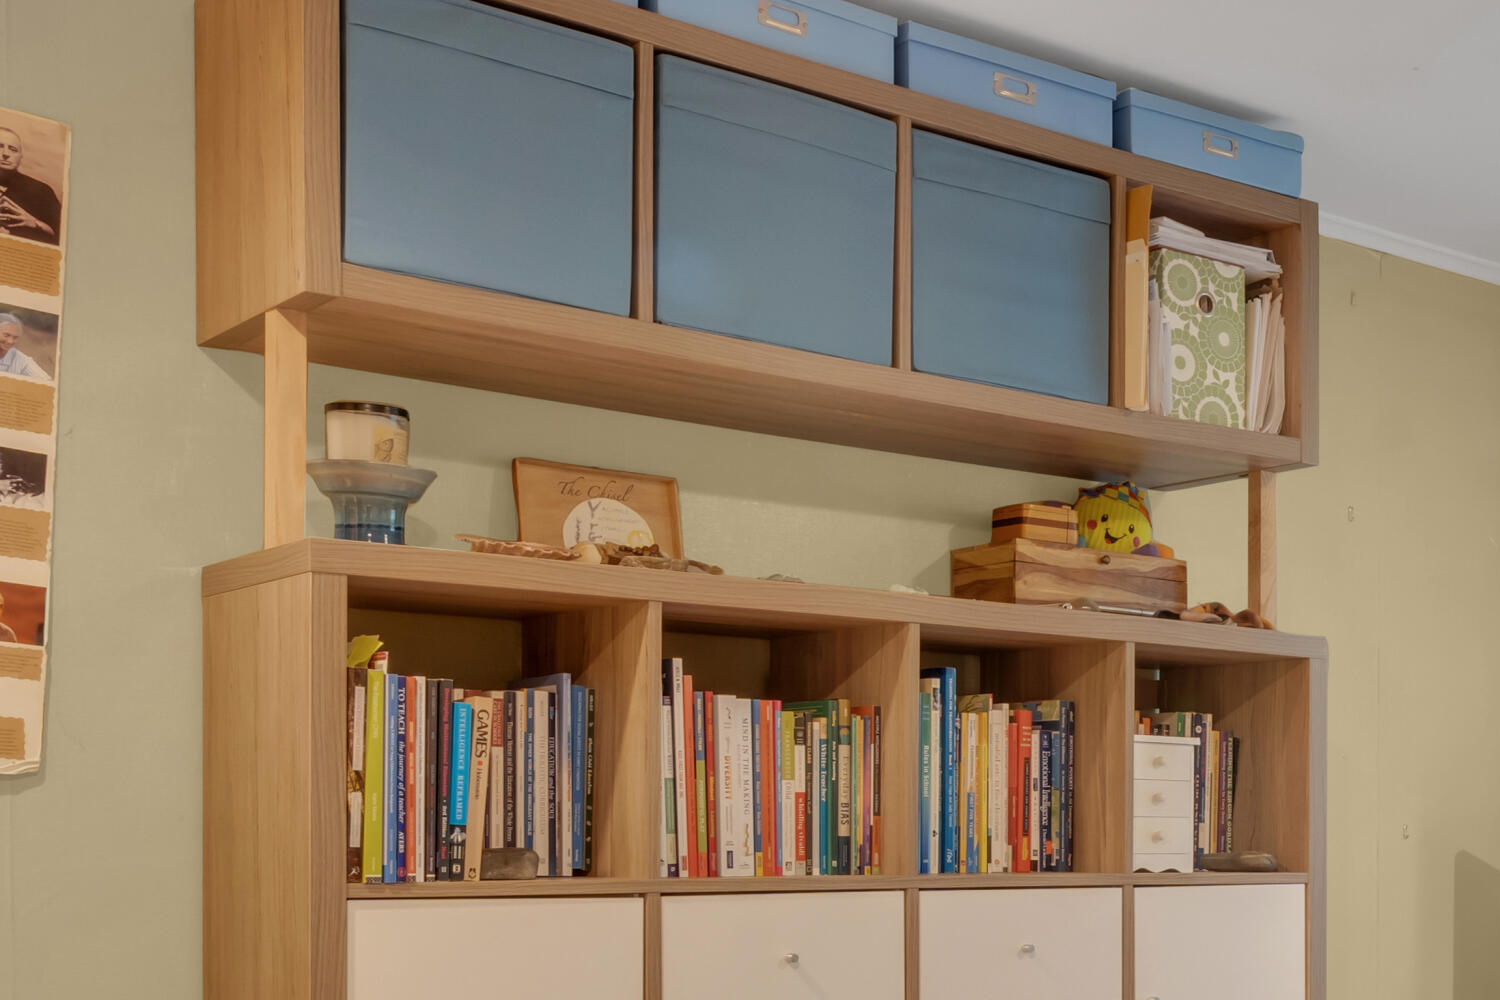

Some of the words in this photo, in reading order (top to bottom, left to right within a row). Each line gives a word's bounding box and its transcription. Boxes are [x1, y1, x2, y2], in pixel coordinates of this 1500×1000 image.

[558, 477, 584, 497] The
[398, 687, 406, 701] TO
[398, 702, 406, 734] TEACH
[475, 709, 490, 759] GAMES
[457, 708, 466, 769] INTELLIGENCE
[742, 744, 749, 754] IN
[398, 754, 406, 778] journey
[723, 755, 732, 800] DIVERSITY
[1042, 751, 1050, 788] Emotional
[398, 797, 406, 824] teacher
[456, 775, 465, 820] REFRAMED
[742, 778, 750, 816] MAKING
[840, 802, 849, 825] BIAS
[1039, 790, 1050, 826] Intelligence
